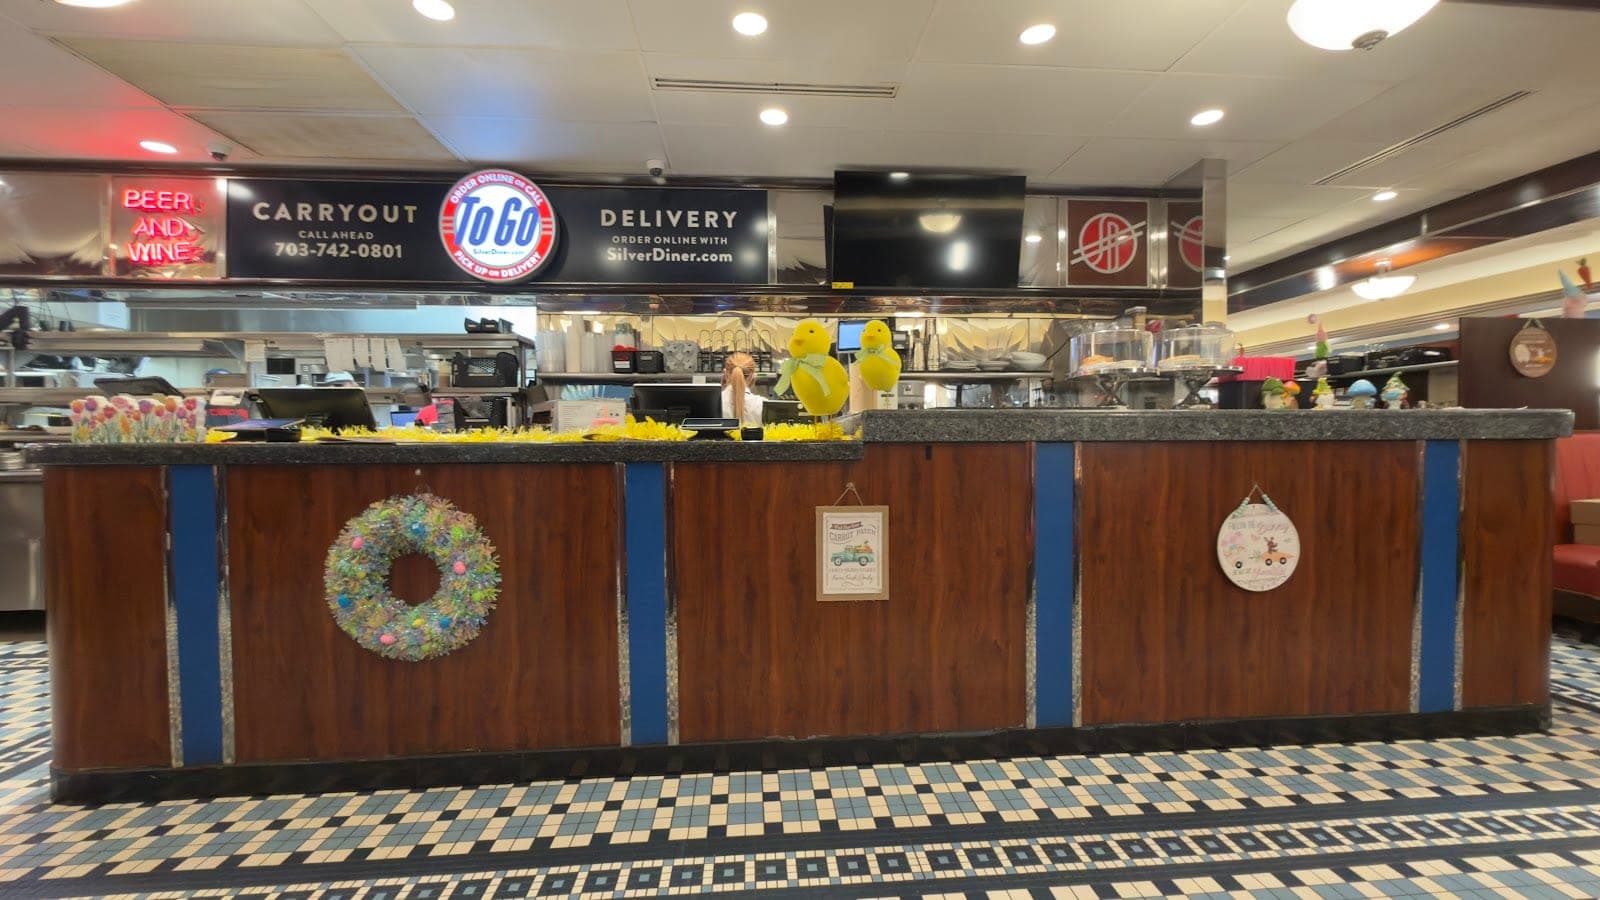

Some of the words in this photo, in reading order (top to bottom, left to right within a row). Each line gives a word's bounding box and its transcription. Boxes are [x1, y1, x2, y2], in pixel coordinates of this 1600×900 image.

[450, 178, 477, 204] ORDER
[477, 174, 515, 184] ONLINE
[524, 186, 544, 206] CALL
[124, 190, 190, 210] BEER
[253, 202, 417, 223] CARRYOUT
[454, 196, 494, 247] To
[494, 197, 540, 247] Go
[600, 209, 737, 228] DELIVERY
[134, 217, 184, 236] AND
[299, 230, 329, 239] CALL
[332, 231, 374, 240] AHEAD
[612, 235, 651, 244] ORDER
[654, 236, 697, 244] ONLINE
[700, 237, 728, 245] WITH
[128, 242, 190, 261] WINE
[275, 243, 402, 258] 703-742-0801
[607, 247, 733, 262] SilverDiner.com
[454, 250, 476, 270] PICK
[474, 266, 489, 277] UP
[501, 251, 542, 278] DELIVERY
